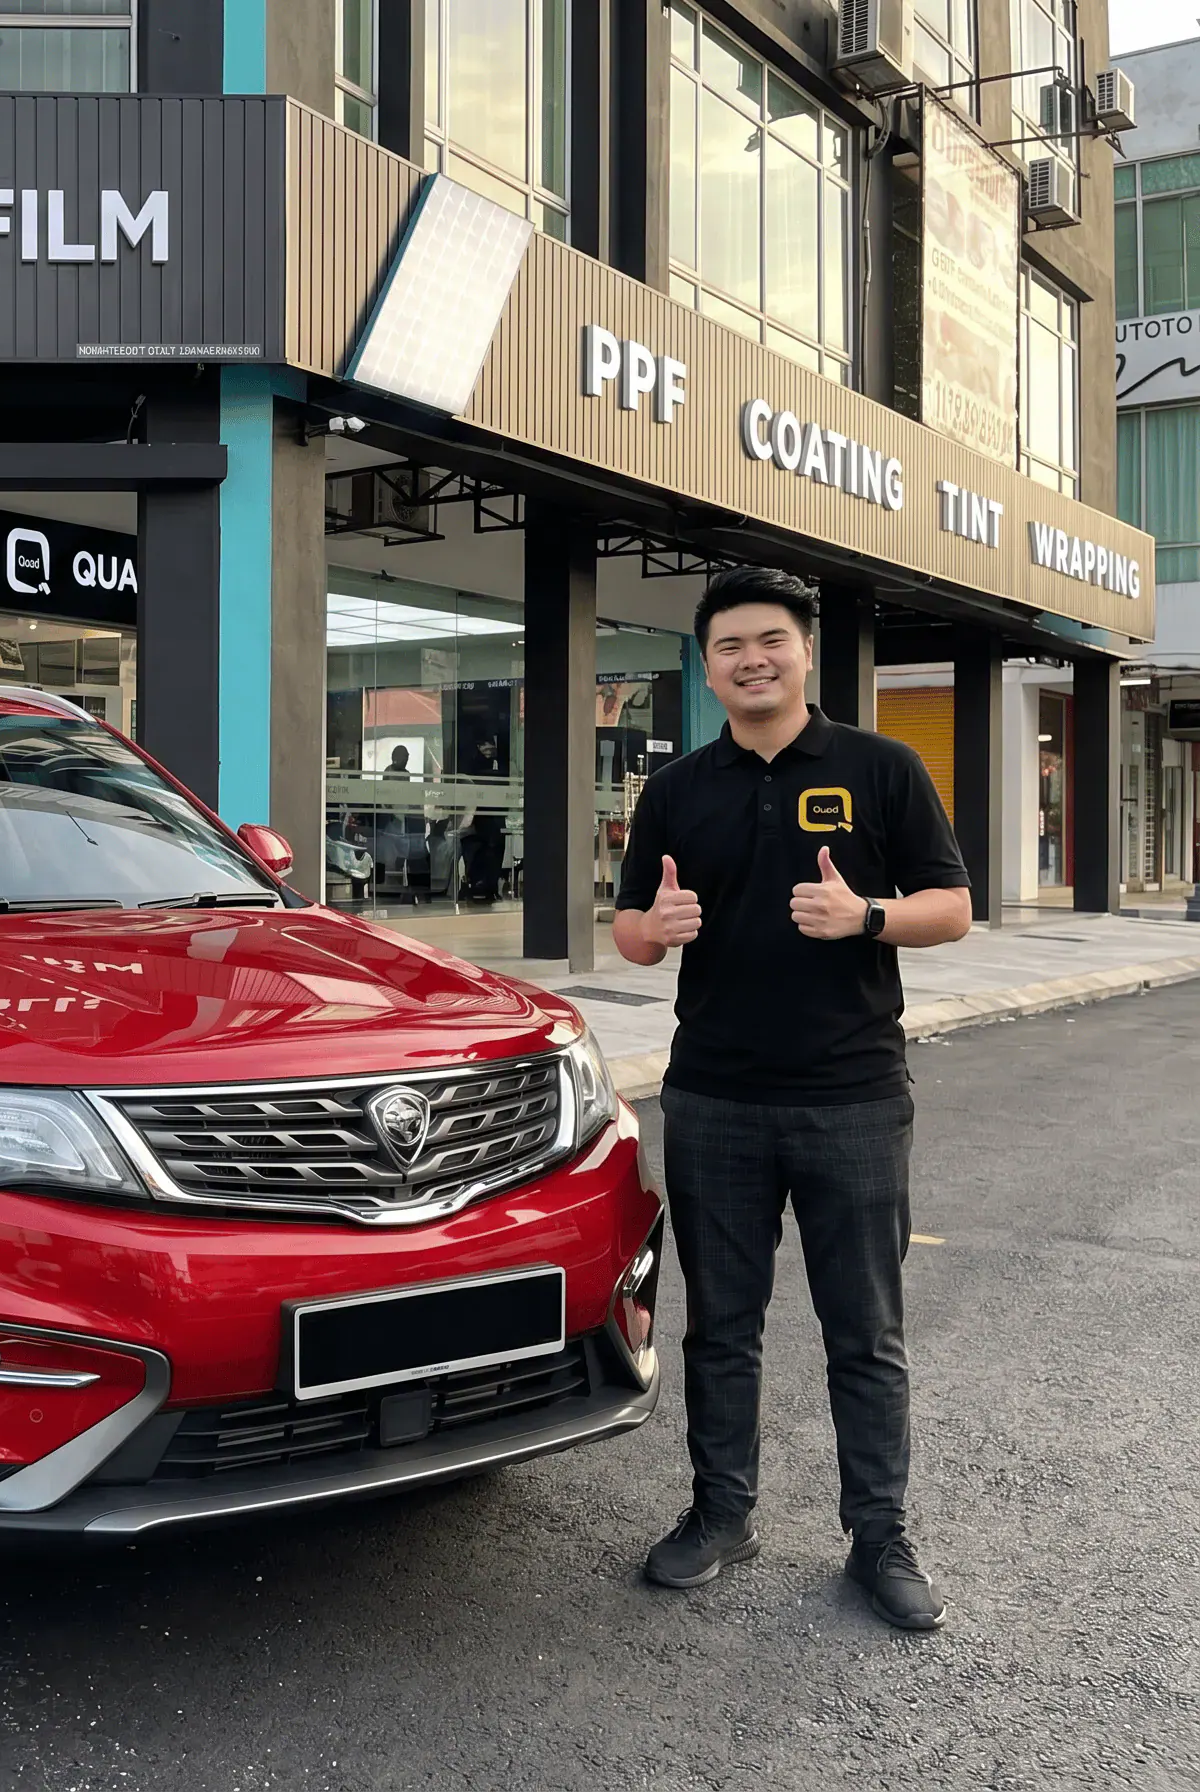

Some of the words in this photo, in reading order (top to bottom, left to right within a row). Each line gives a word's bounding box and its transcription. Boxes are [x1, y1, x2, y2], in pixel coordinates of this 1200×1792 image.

[587, 324, 687, 424] PPF
[745, 398, 904, 511] COATING
[936, 479, 1004, 548] TINT
[72, 550, 138, 594] QUA
[1029, 520, 1141, 599] WRAPPING
